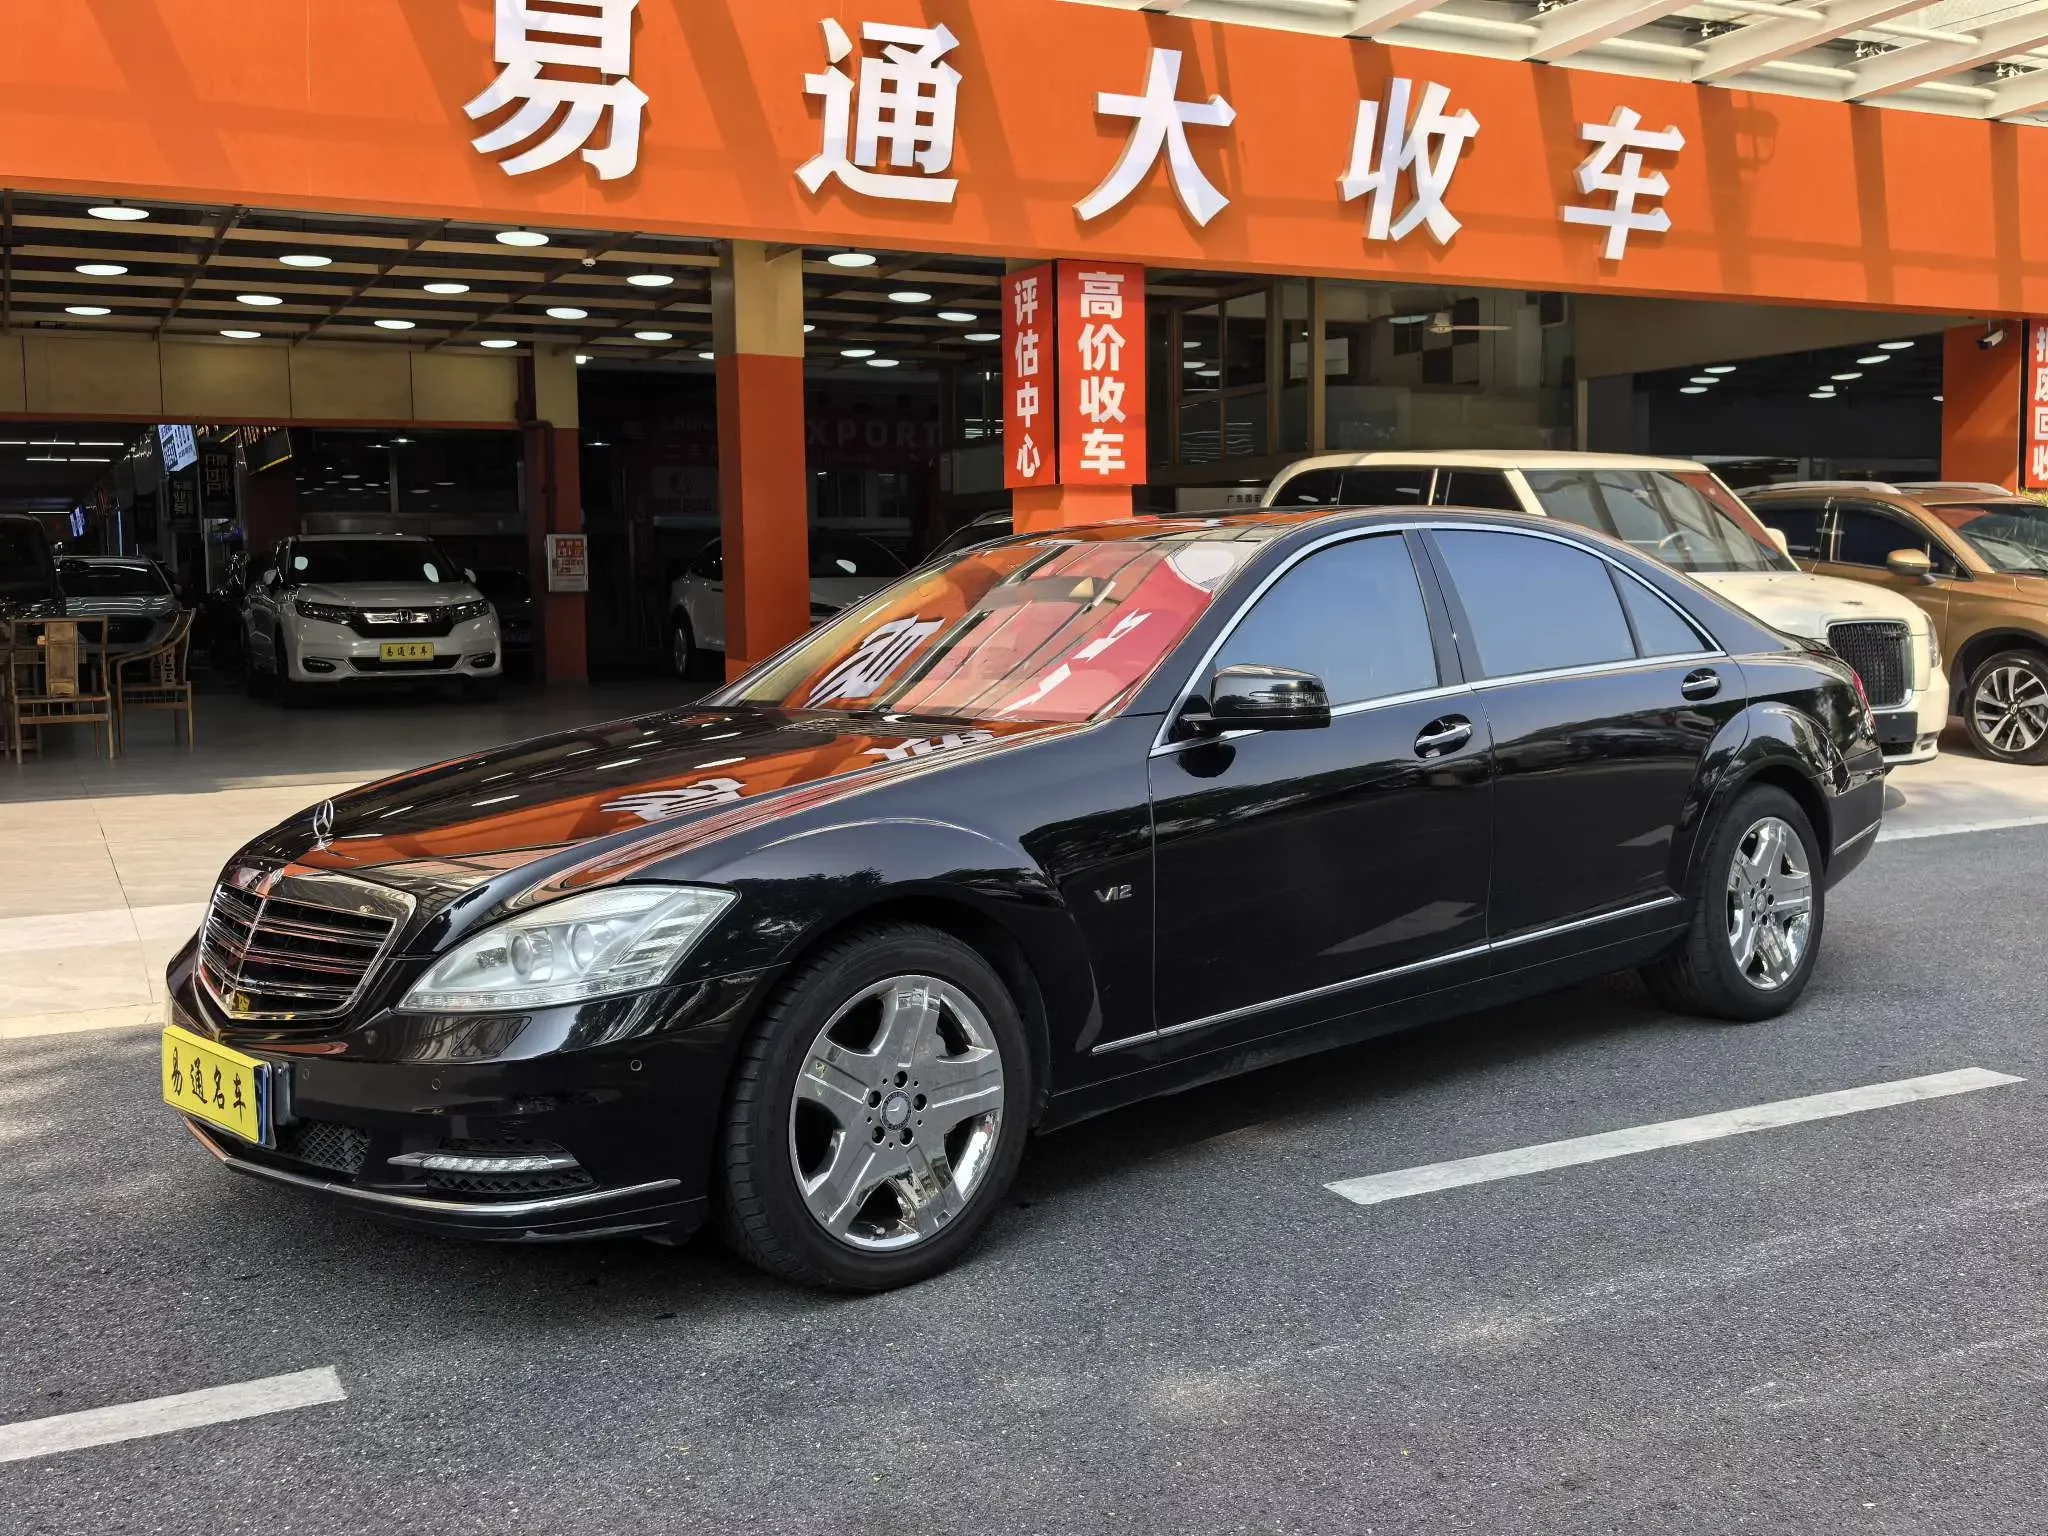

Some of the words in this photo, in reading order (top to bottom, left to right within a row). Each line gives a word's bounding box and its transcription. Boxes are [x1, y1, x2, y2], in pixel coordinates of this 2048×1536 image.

[463, 0, 1686, 261] 易通大收车
[1014, 276, 1041, 478] 评估中心
[1077, 271, 1127, 476] 高价收车
[1093, 884, 1133, 903] V12
